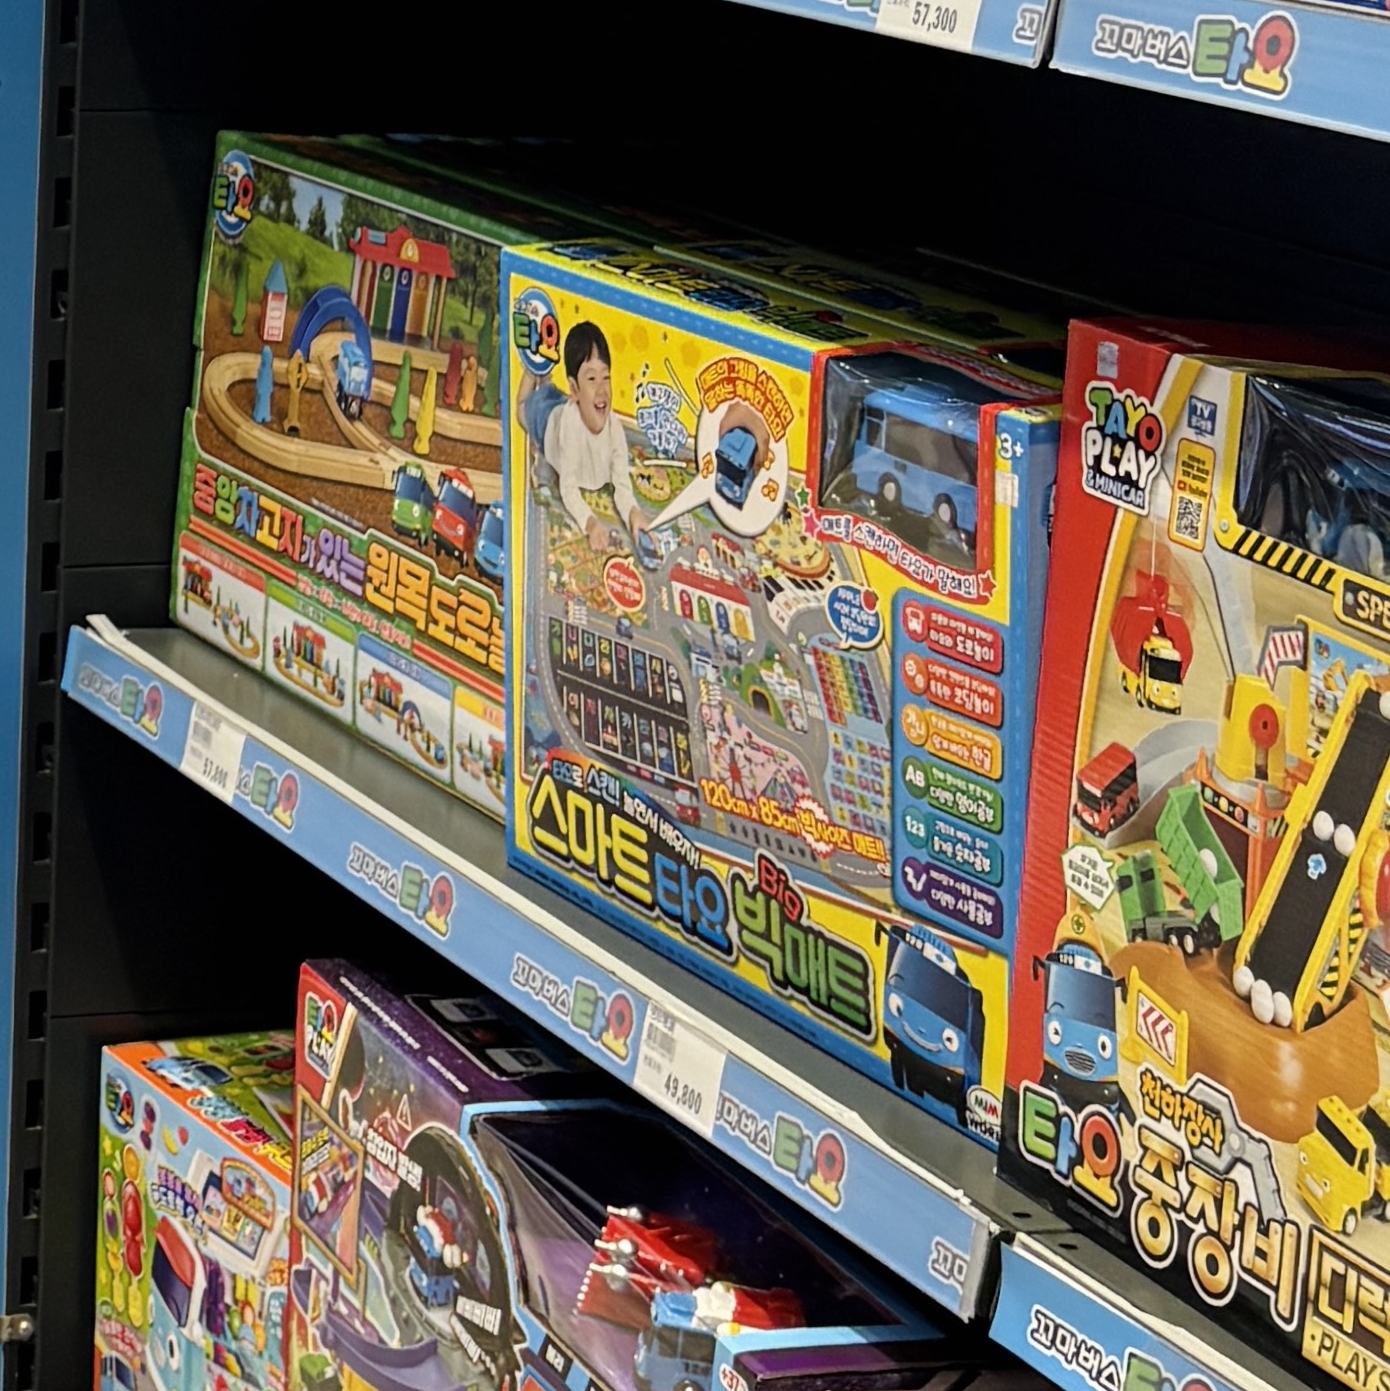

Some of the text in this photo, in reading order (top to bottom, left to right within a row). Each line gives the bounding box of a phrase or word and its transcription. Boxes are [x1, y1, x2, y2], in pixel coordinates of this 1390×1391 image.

[911, 1, 958, 34] 57,300
[1094, 13, 1191, 68] 꼬마버스
[1191, 11, 1297, 99] 타요
[512, 310, 561, 363] 타요
[996, 431, 1025, 463] 3+
[1088, 386, 1162, 453] TAYO
[1084, 427, 1157, 490] PLAY
[1094, 473, 1145, 510] MINICAR
[316, 527, 367, 598] 있는
[120, 675, 164, 739] 타요
[250, 761, 300, 834] 타요
[699, 778, 750, 819] 120cm
[757, 796, 801, 834] 85cm
[905, 765, 925, 789] AB
[905, 815, 925, 838] 123
[398, 860, 454, 938] 타요
[531, 774, 873, 1032] 스마트 타요 빅매트
[758, 860, 804, 922] Big
[511, 953, 635, 1066] 꼬마버스 타요
[663, 1070, 705, 1116] 49,800
[1139, 1067, 1224, 1157] 천하장사
[717, 1091, 848, 1209] 마버스 타요
[1019, 1088, 1123, 1210] 타요
[1132, 1125, 1301, 1324] 중장비
